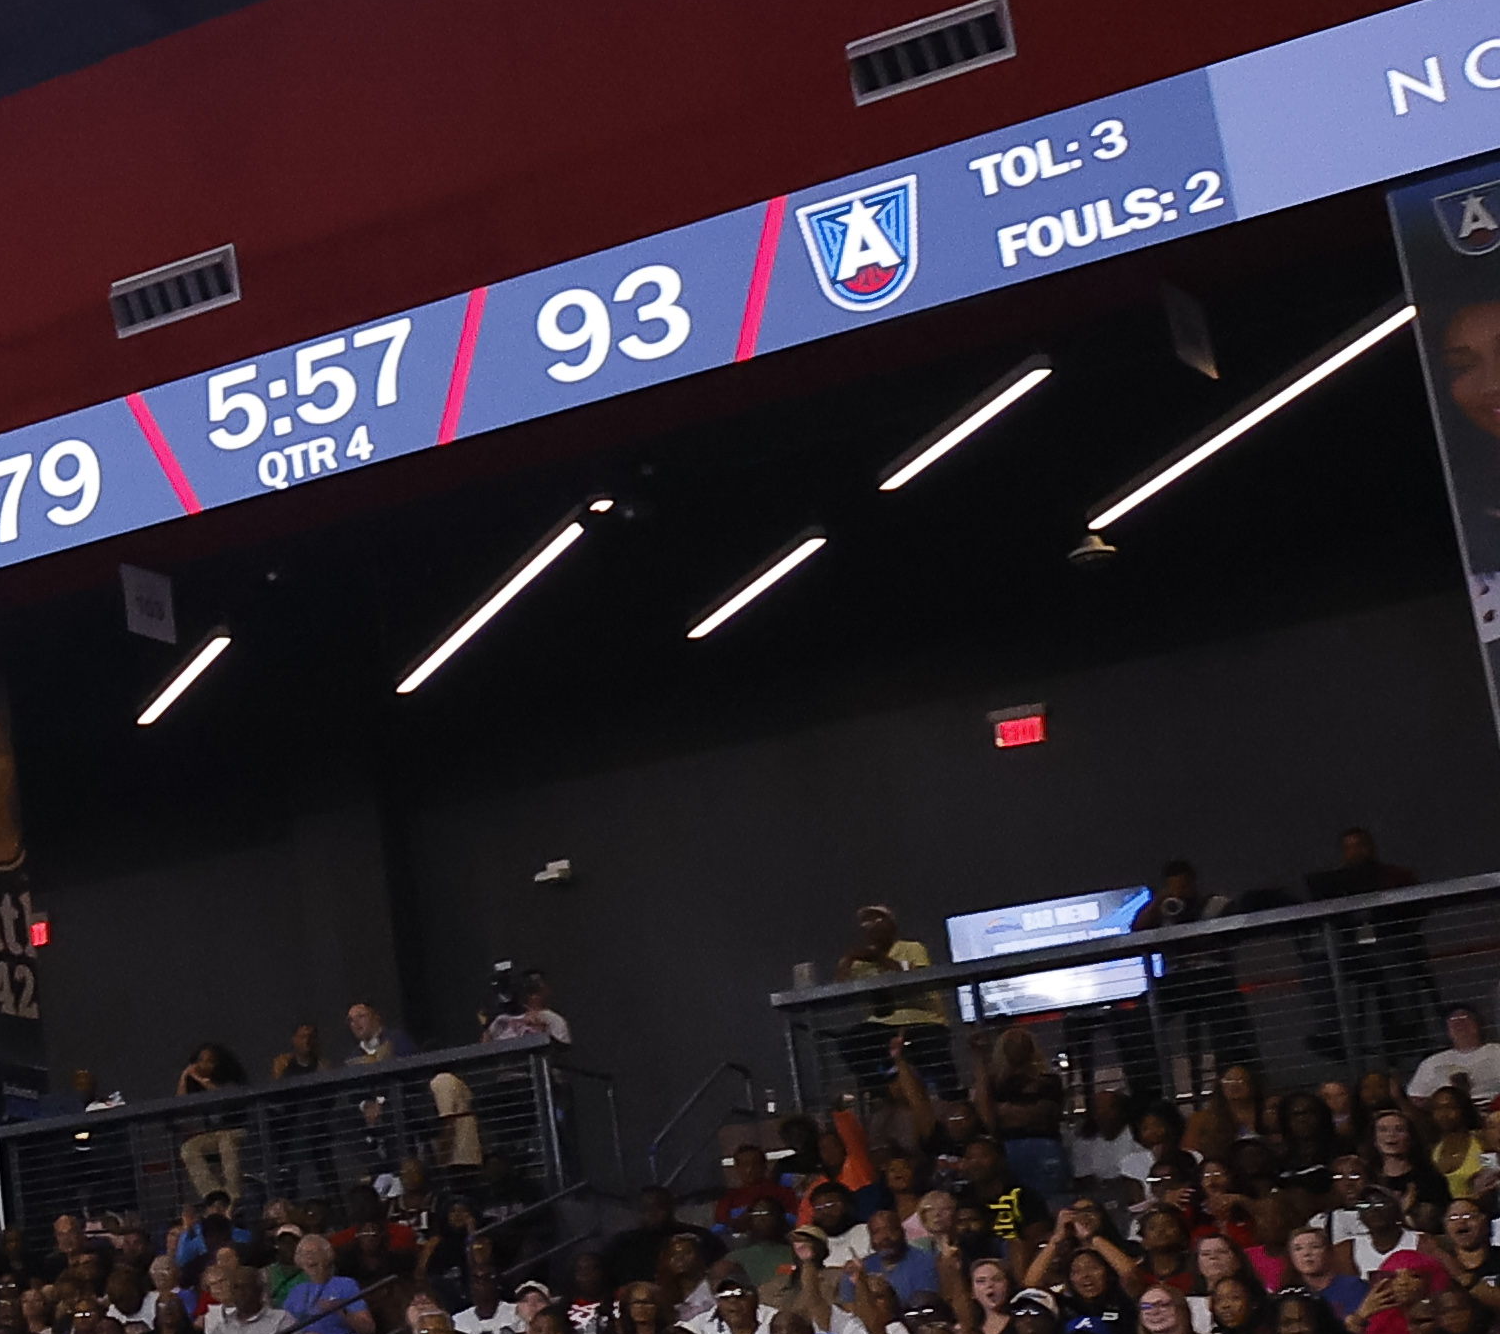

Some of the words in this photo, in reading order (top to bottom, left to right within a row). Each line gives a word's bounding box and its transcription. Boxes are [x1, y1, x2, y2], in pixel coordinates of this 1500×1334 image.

[968, 138, 1083, 198] TOL:
[1089, 117, 1129, 161] 3
[996, 185, 1179, 268] FOULS:
[1185, 170, 1227, 217] 2
[534, 263, 693, 384] 93
[205, 316, 413, 452] 5:57
[257, 436, 338, 490] QTR
[346, 424, 374, 464] 4
